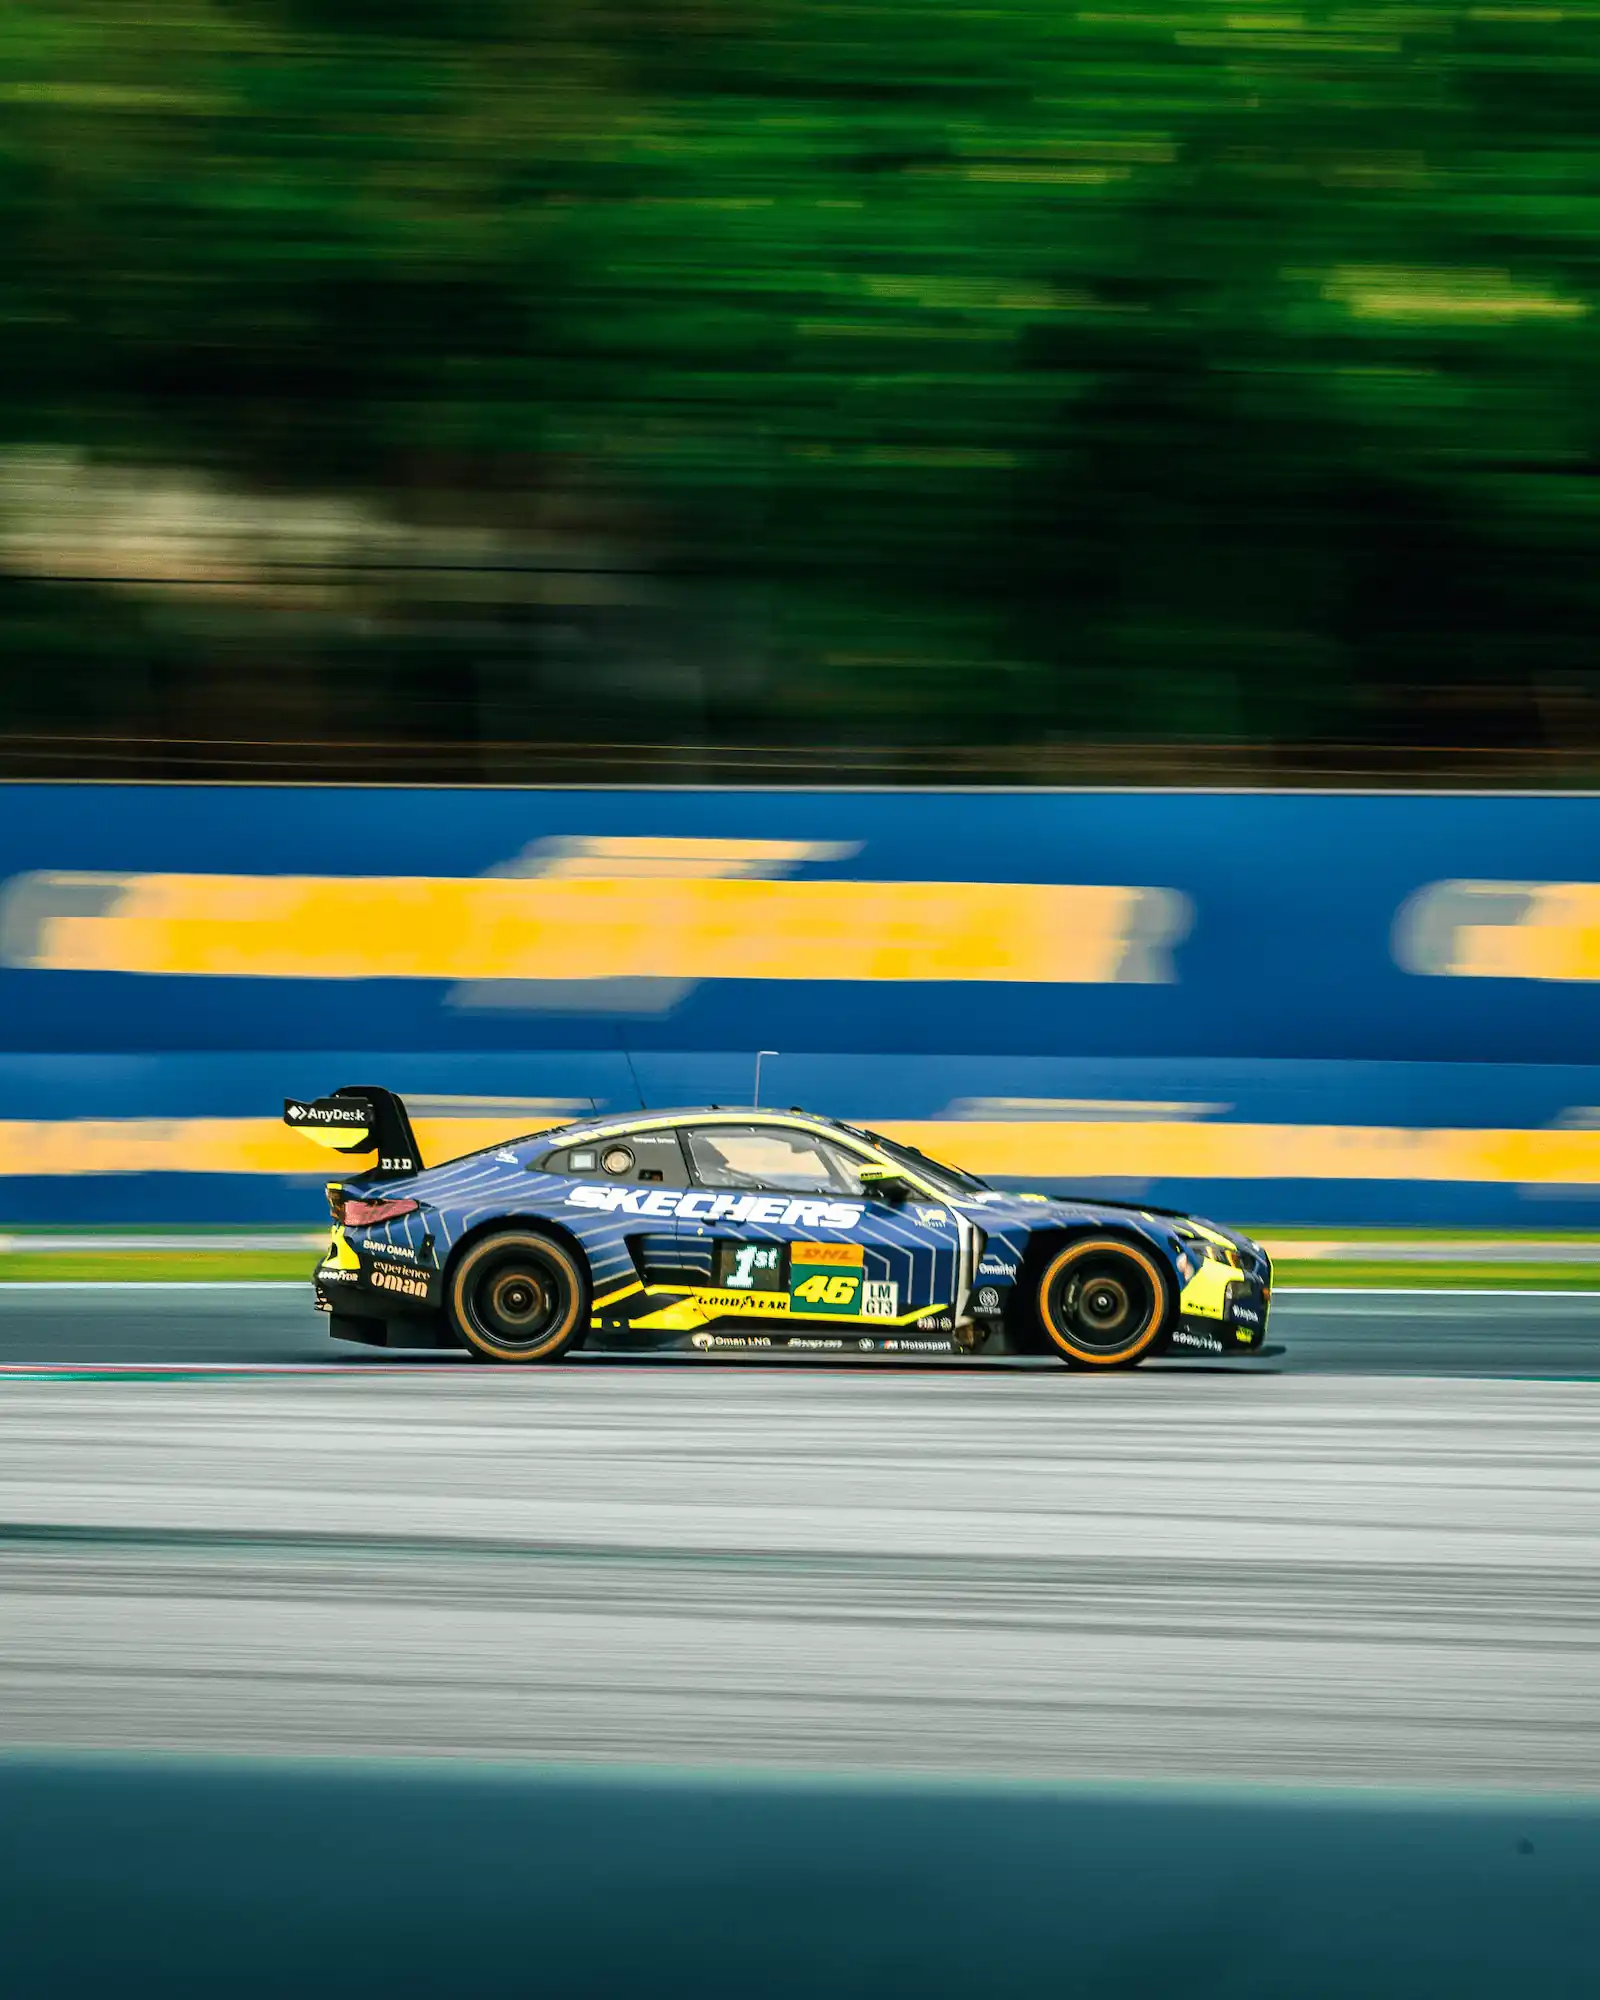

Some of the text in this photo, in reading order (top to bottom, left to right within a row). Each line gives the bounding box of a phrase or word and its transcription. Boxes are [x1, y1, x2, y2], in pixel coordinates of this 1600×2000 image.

[307, 1107, 365, 1122] AnyDesk
[564, 1186, 865, 1229] SKECHERS
[363, 1240, 415, 1259] BMW OMAN
[802, 1247, 852, 1261] DHL
[373, 1261, 430, 1280] experience
[726, 1245, 778, 1288] 1st
[371, 1272, 428, 1298] oman
[794, 1275, 860, 1305] 46
[869, 1284, 891, 1298] LM
[866, 1299, 893, 1316] GT3
[715, 1336, 771, 1346] Oman LNG
[901, 1340, 951, 1351] Motorsport
